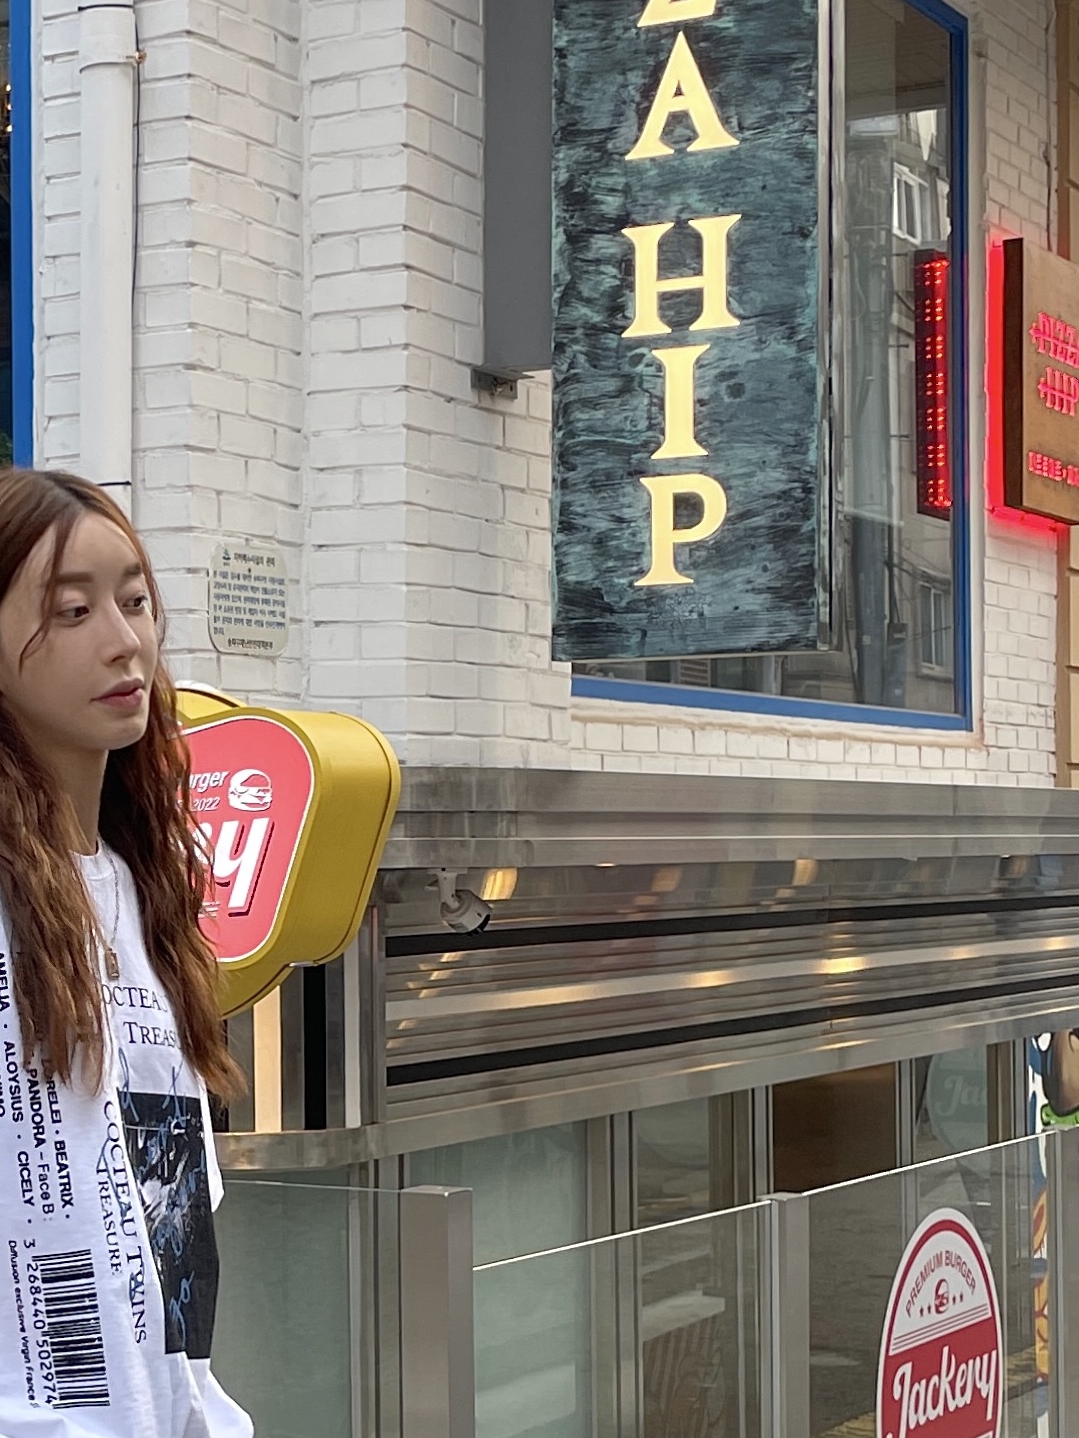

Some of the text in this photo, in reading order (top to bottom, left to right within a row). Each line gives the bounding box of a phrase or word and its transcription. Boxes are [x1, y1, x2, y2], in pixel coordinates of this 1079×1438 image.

[188, 771, 230, 793] rger
[122, 1021, 182, 1049] TREAS
[3, 1041, 24, 1123] ALOYSIUS
[17, 1150, 35, 1207] CICELY
[27, 1068, 47, 1149] PANDORA
[37, 1163, 51, 1201] Face
[54, 1139, 75, 1209] BEATRIX
[104, 1100, 147, 1344] COCTEAU TWINS
[905, 1250, 976, 1318] PREMIUM BURGER
